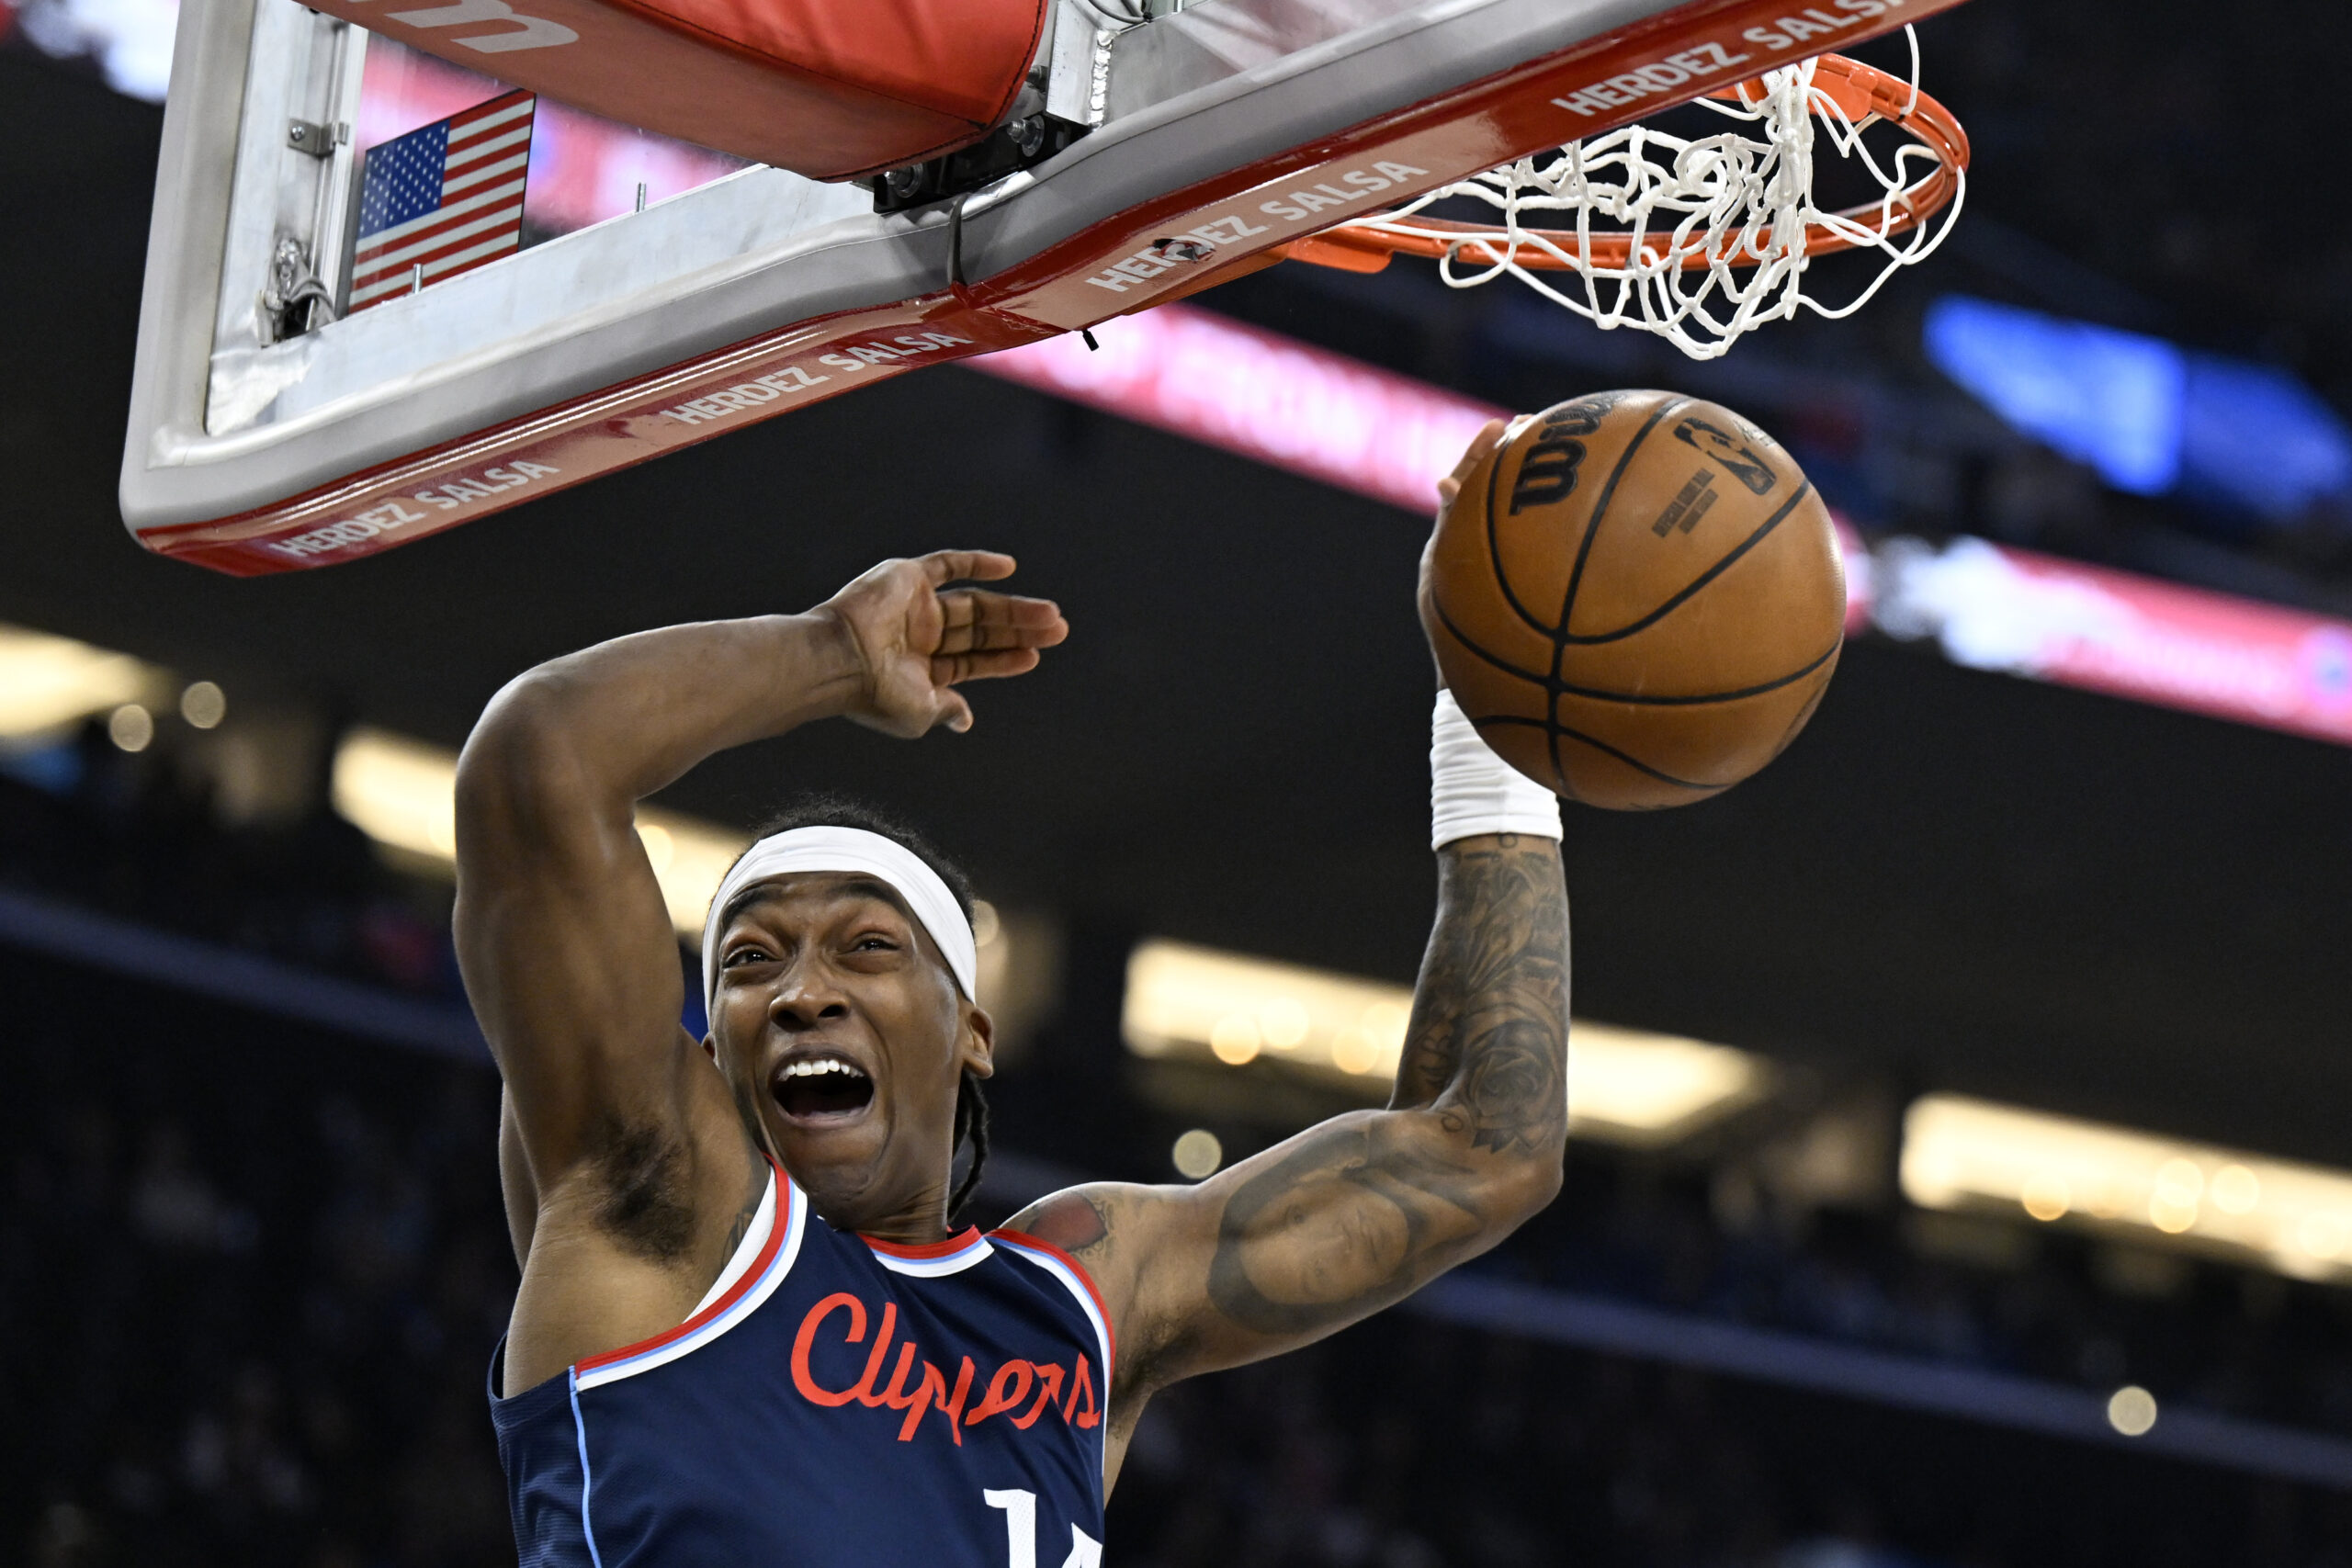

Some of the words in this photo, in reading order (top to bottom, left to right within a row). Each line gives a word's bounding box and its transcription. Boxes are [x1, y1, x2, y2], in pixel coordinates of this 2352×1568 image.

[1551, 41, 1749, 117] HERDEZ
[1742, 0, 1905, 51] SALS
[1259, 160, 1430, 221] SALSA
[660, 366, 831, 425] HERDEZ
[818, 332, 975, 372] SALSA
[268, 502, 428, 558] HERDEZ
[414, 459, 561, 510] SALSA
[790, 1292, 1102, 1447] Clippers
